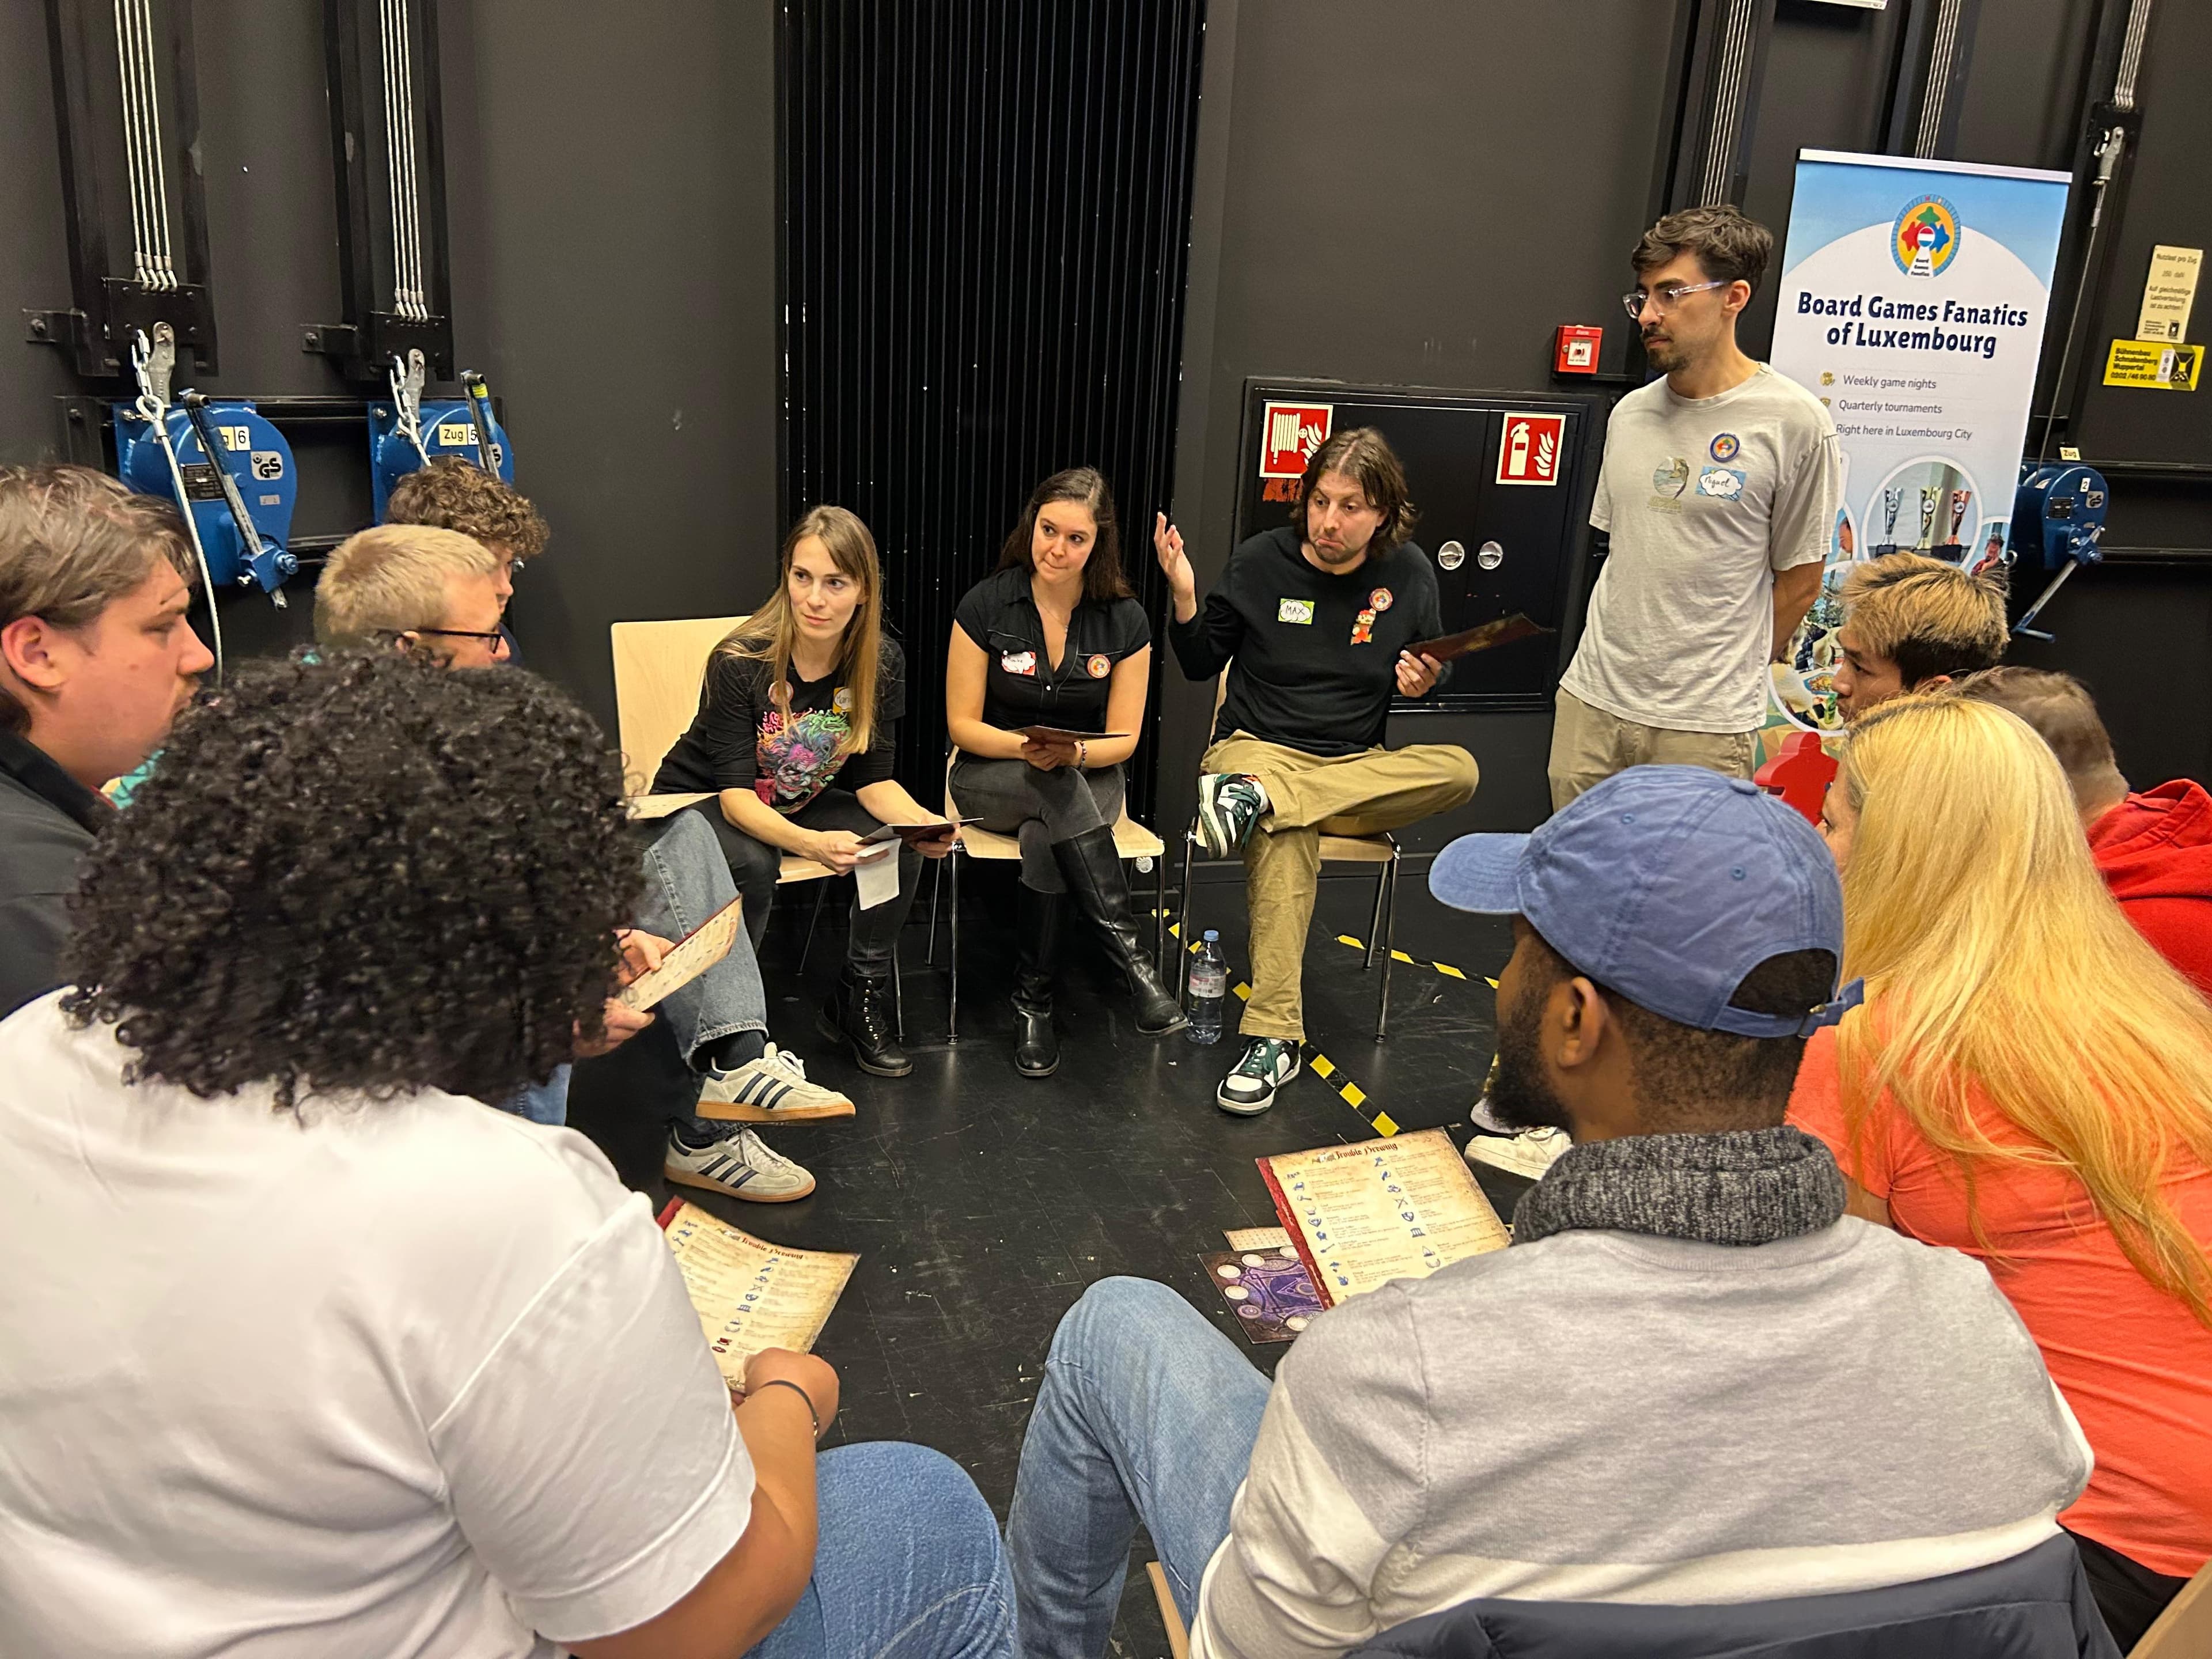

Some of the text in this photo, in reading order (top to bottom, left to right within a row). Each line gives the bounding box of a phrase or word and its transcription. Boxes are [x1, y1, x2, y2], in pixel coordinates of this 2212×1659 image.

[1798, 291, 2028, 326] Board Games Fanatics
[1827, 322, 1997, 359] of Luxembourg
[1843, 375, 1936, 390] Weekly game nights
[1839, 400, 1942, 414] Quarterly tournaments
[238, 430, 246, 444] 6
[444, 429, 478, 442] Zug 5
[1836, 424, 1973, 440] Right here in Luxembourg City
[2063, 449, 2077, 458] Zug
[2082, 481, 2088, 489] 2
[1286, 605, 1305, 615] MAX
[1335, 1149, 1362, 1160] Trouble
[1364, 1142, 1398, 1156] Brewing
[741, 1237, 767, 1252] Trouble
